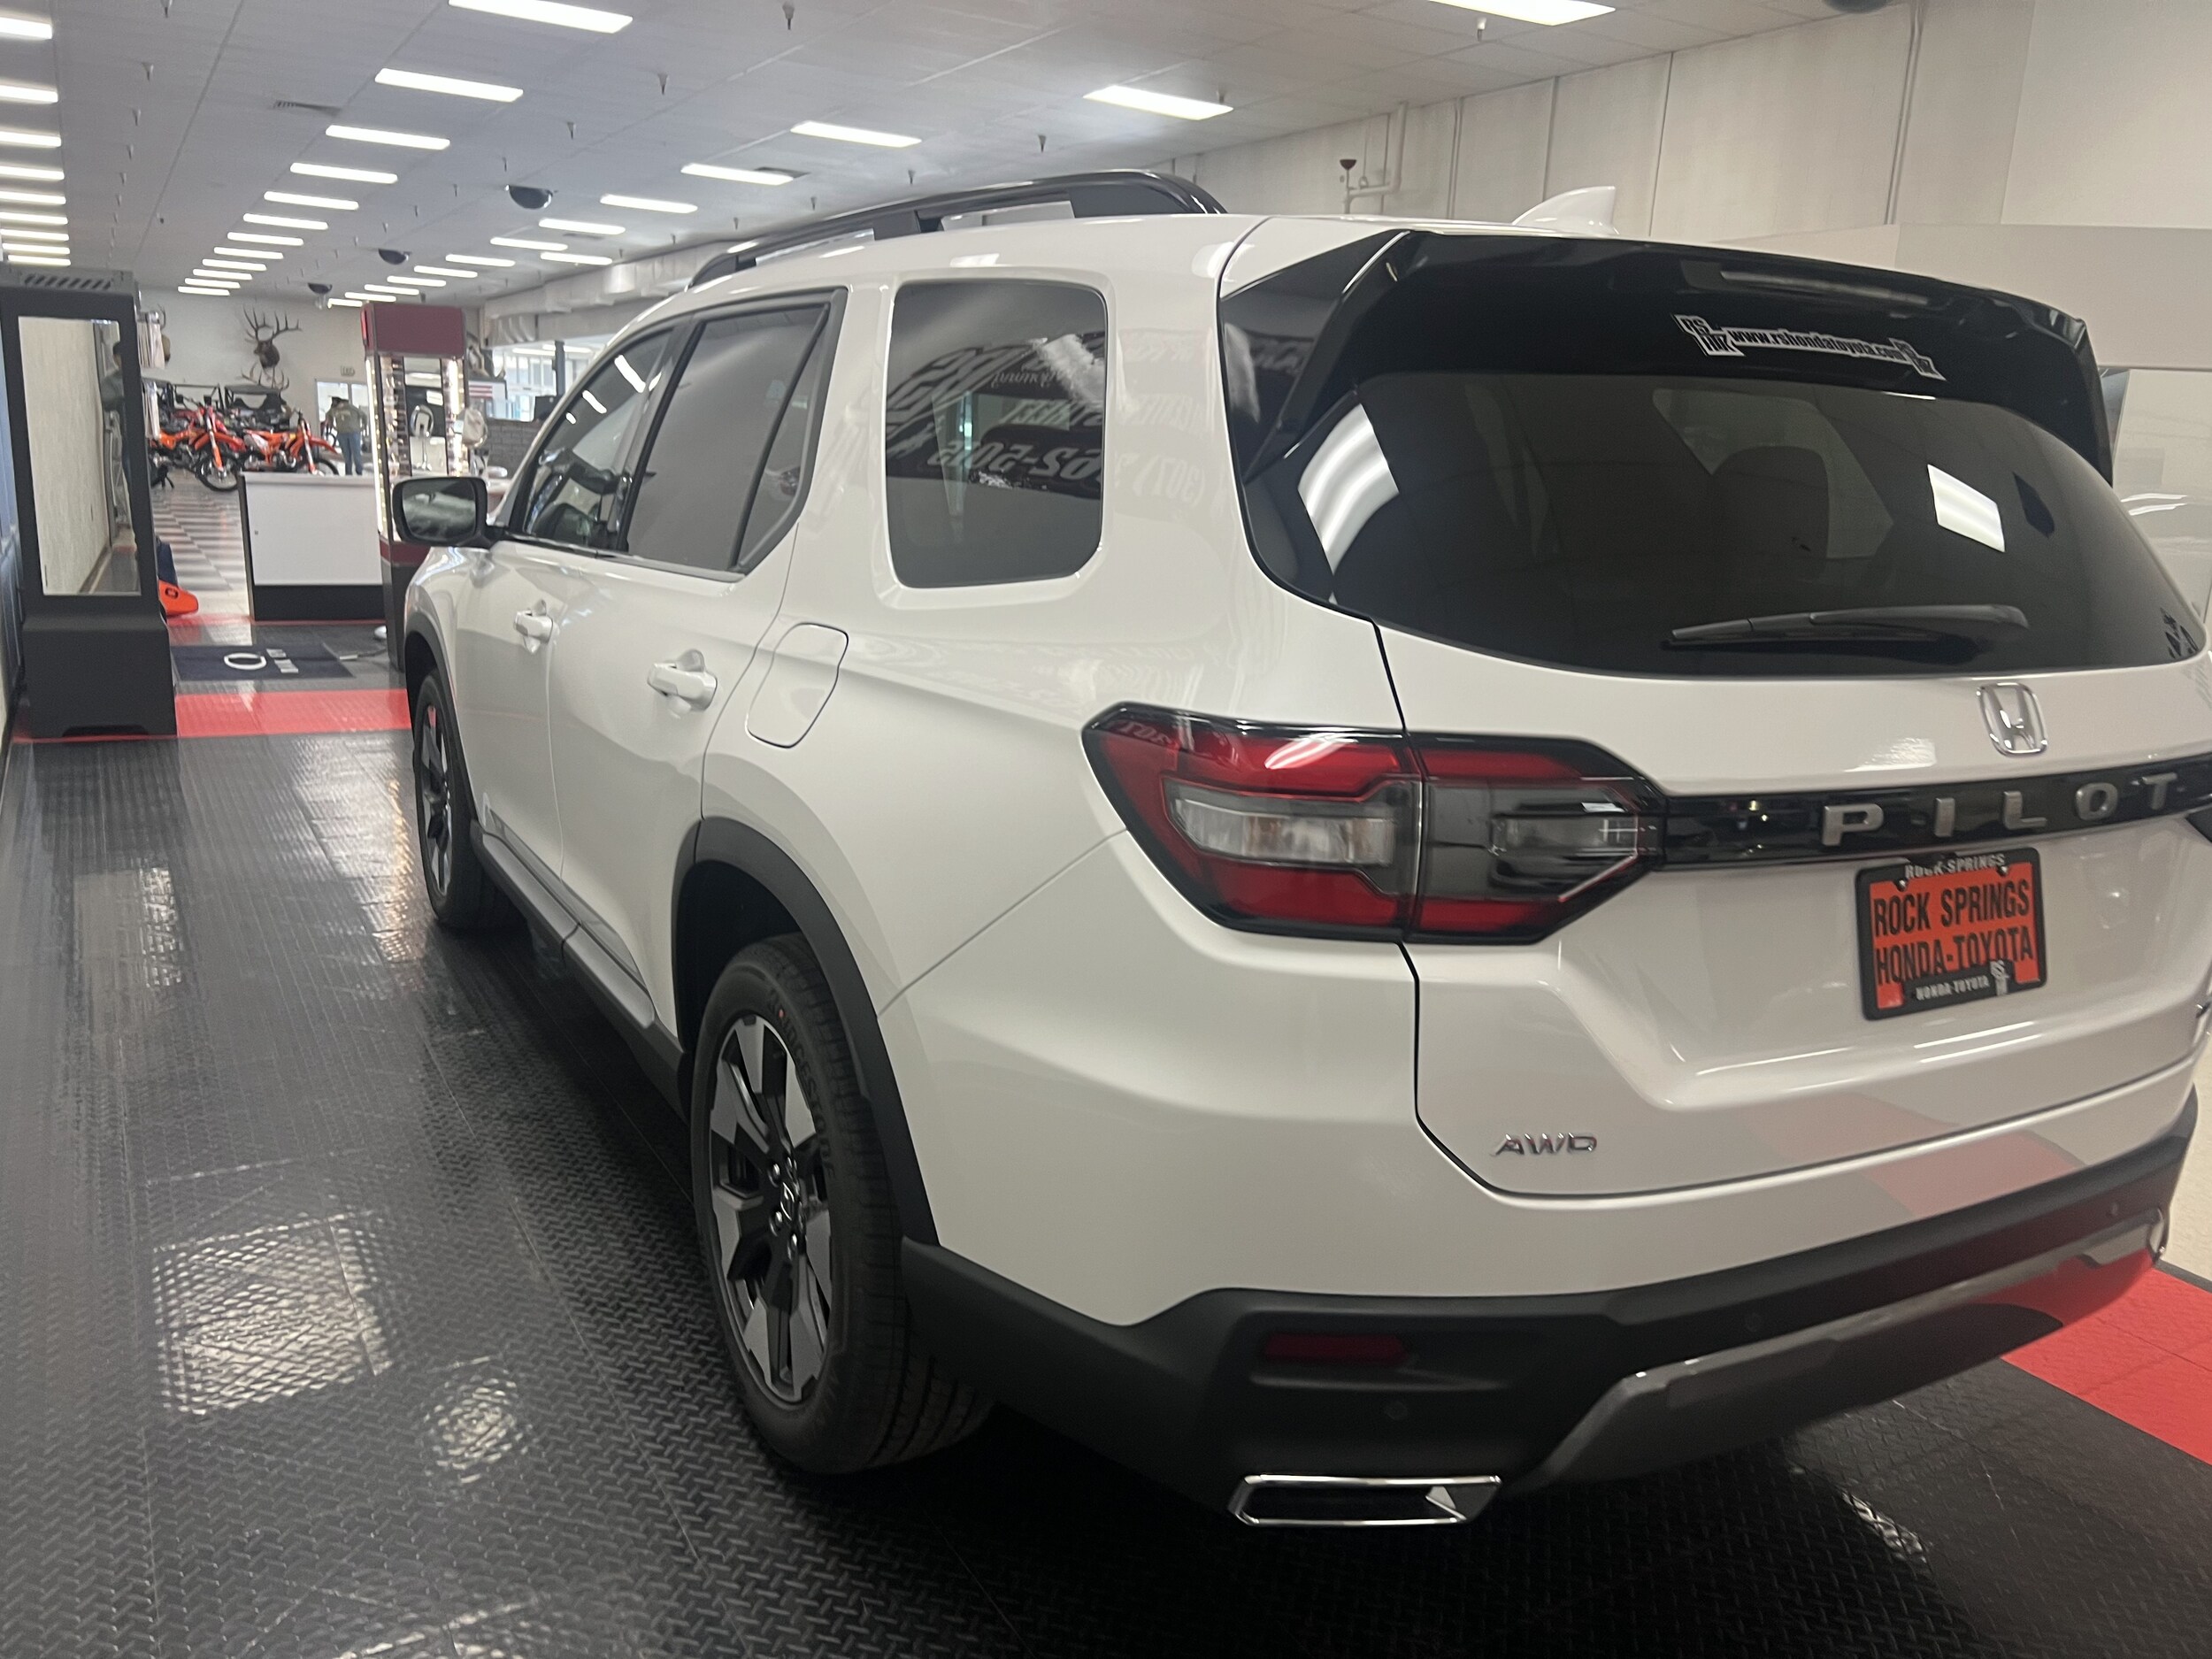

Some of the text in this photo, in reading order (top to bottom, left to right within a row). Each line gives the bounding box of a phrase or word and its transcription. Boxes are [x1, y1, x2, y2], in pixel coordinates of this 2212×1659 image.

[1727, 329, 1909, 362] www.rshondatoyota.com
[1821, 772, 2177, 847] PILOT
[1947, 852, 2006, 874] SPRINGS
[1873, 879, 2031, 937] ROCK SPRINGS
[1490, 1132, 1598, 1157] AWD
